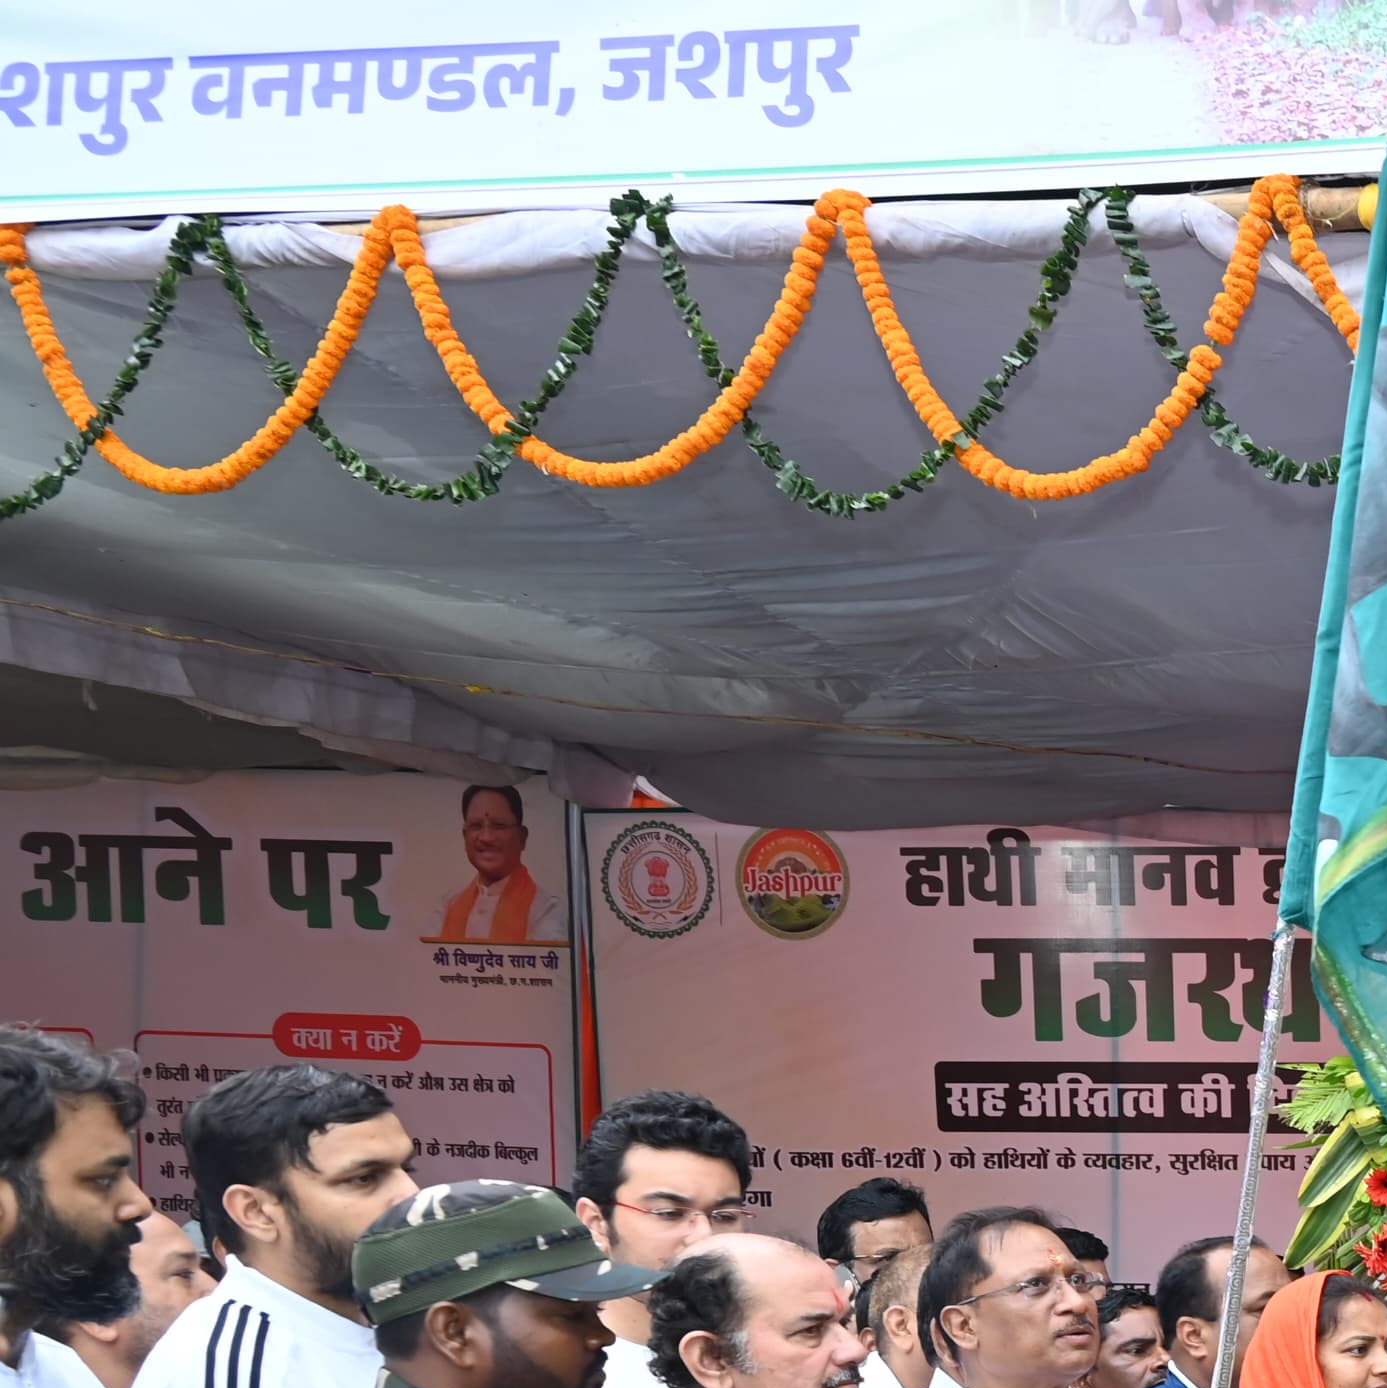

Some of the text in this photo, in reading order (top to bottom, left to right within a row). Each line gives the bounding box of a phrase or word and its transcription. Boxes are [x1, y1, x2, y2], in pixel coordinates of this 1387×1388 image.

[0, 25, 860, 156] शपुर वनमण्डल, जशपुर
[20, 807, 392, 930] आने पर
[900, 828, 1041, 906] हाथी
[1061, 847, 1240, 906] मानव
[745, 867, 842, 899] Jashpur
[433, 947, 449, 966] श्री
[508, 955, 536, 968] साय
[540, 950, 558, 969] जी
[291, 1024, 403, 1053] क्या न करें
[156, 1062, 189, 1081] किसी
[194, 1064, 209, 1082] भी
[391, 1071, 414, 1089] करें
[448, 1077, 469, 1092] उस
[497, 1074, 515, 1093] को
[156, 1097, 183, 1117] तुरंत
[945, 1080, 1009, 1117] सह
[1018, 1072, 1166, 1118] अस्तित्व
[1178, 1072, 1236, 1118] की
[426, 1138, 441, 1156] के
[445, 1140, 490, 1158] नजदीक
[495, 1141, 539, 1165] बिल्कुल
[789, 1151, 834, 1169] कक्षा
[949, 1146, 975, 1170] को
[983, 1146, 1049, 1171] हाथियों
[1057, 1147, 1077, 1170] के
[1083, 1152, 1161, 1174] व्यवहार,
[1168, 1148, 1239, 1173] सुरक्षित
[160, 1161, 174, 1178] भी
